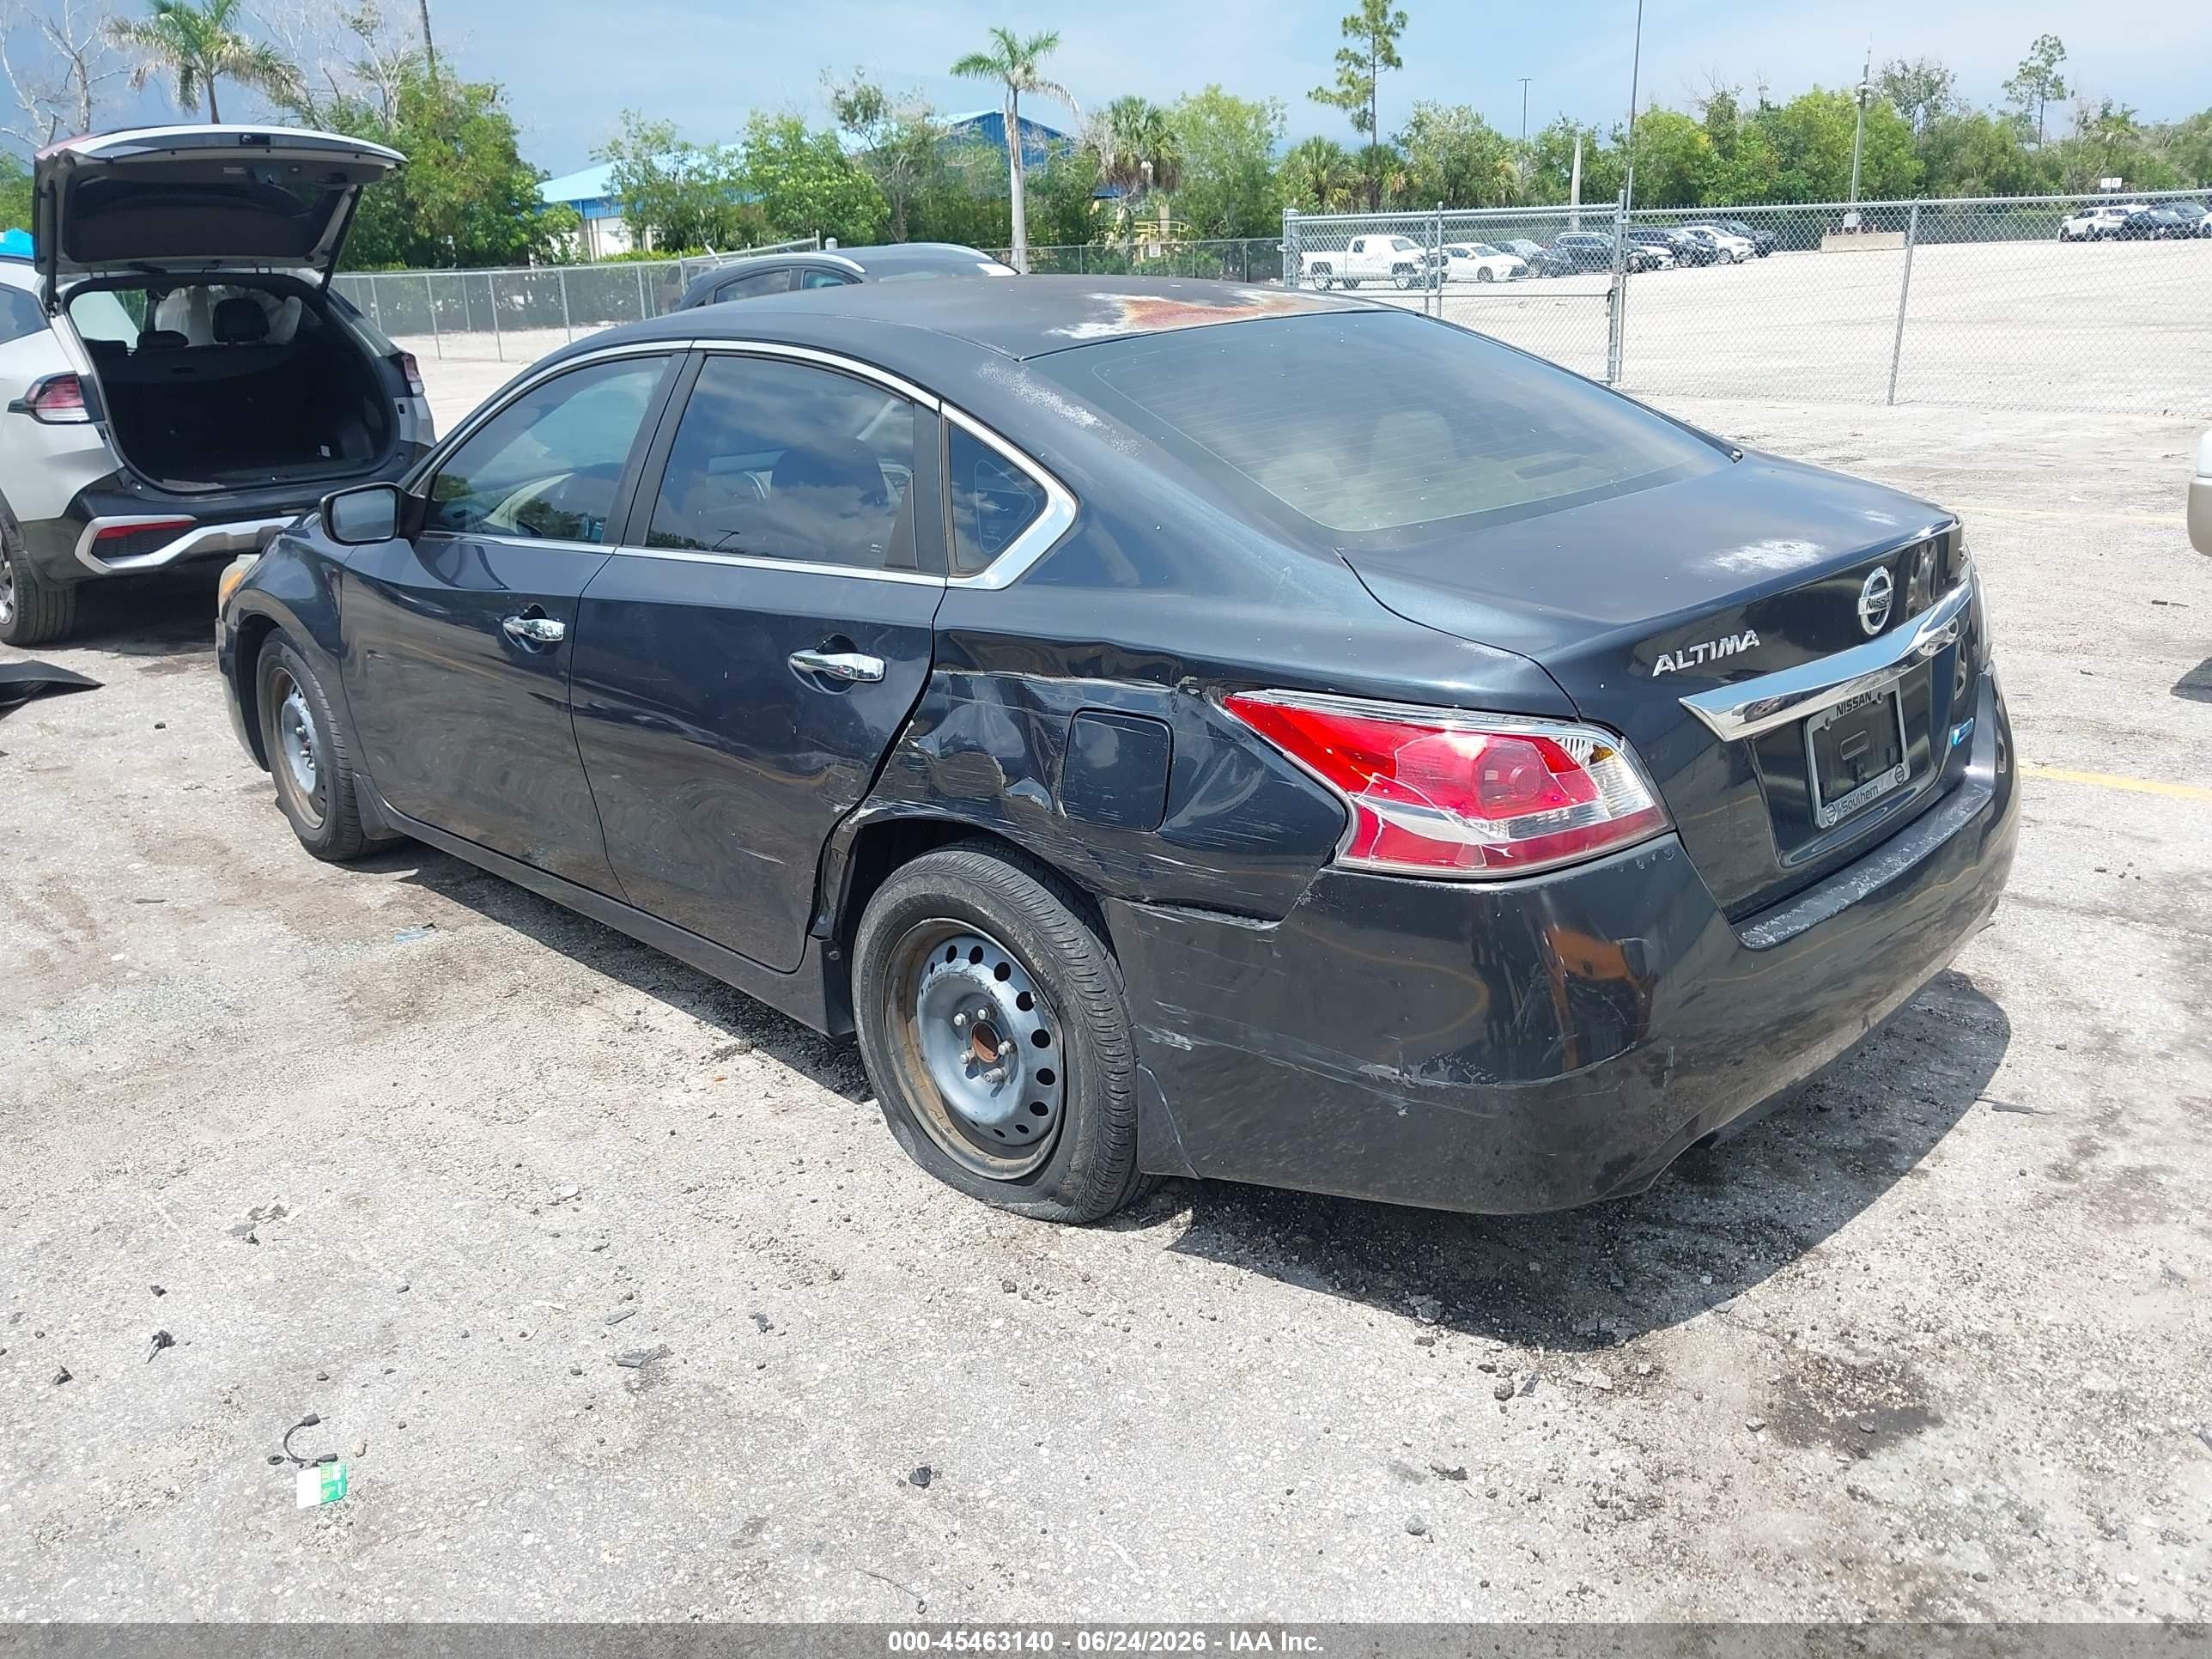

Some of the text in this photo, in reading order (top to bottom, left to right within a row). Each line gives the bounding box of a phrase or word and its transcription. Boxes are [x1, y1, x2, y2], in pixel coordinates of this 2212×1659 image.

[1865, 591, 1891, 611] NISS
[1652, 629, 1760, 678] ALTIMA
[1836, 690, 1872, 717] NISSAN
[1841, 785, 1879, 813] Southern
